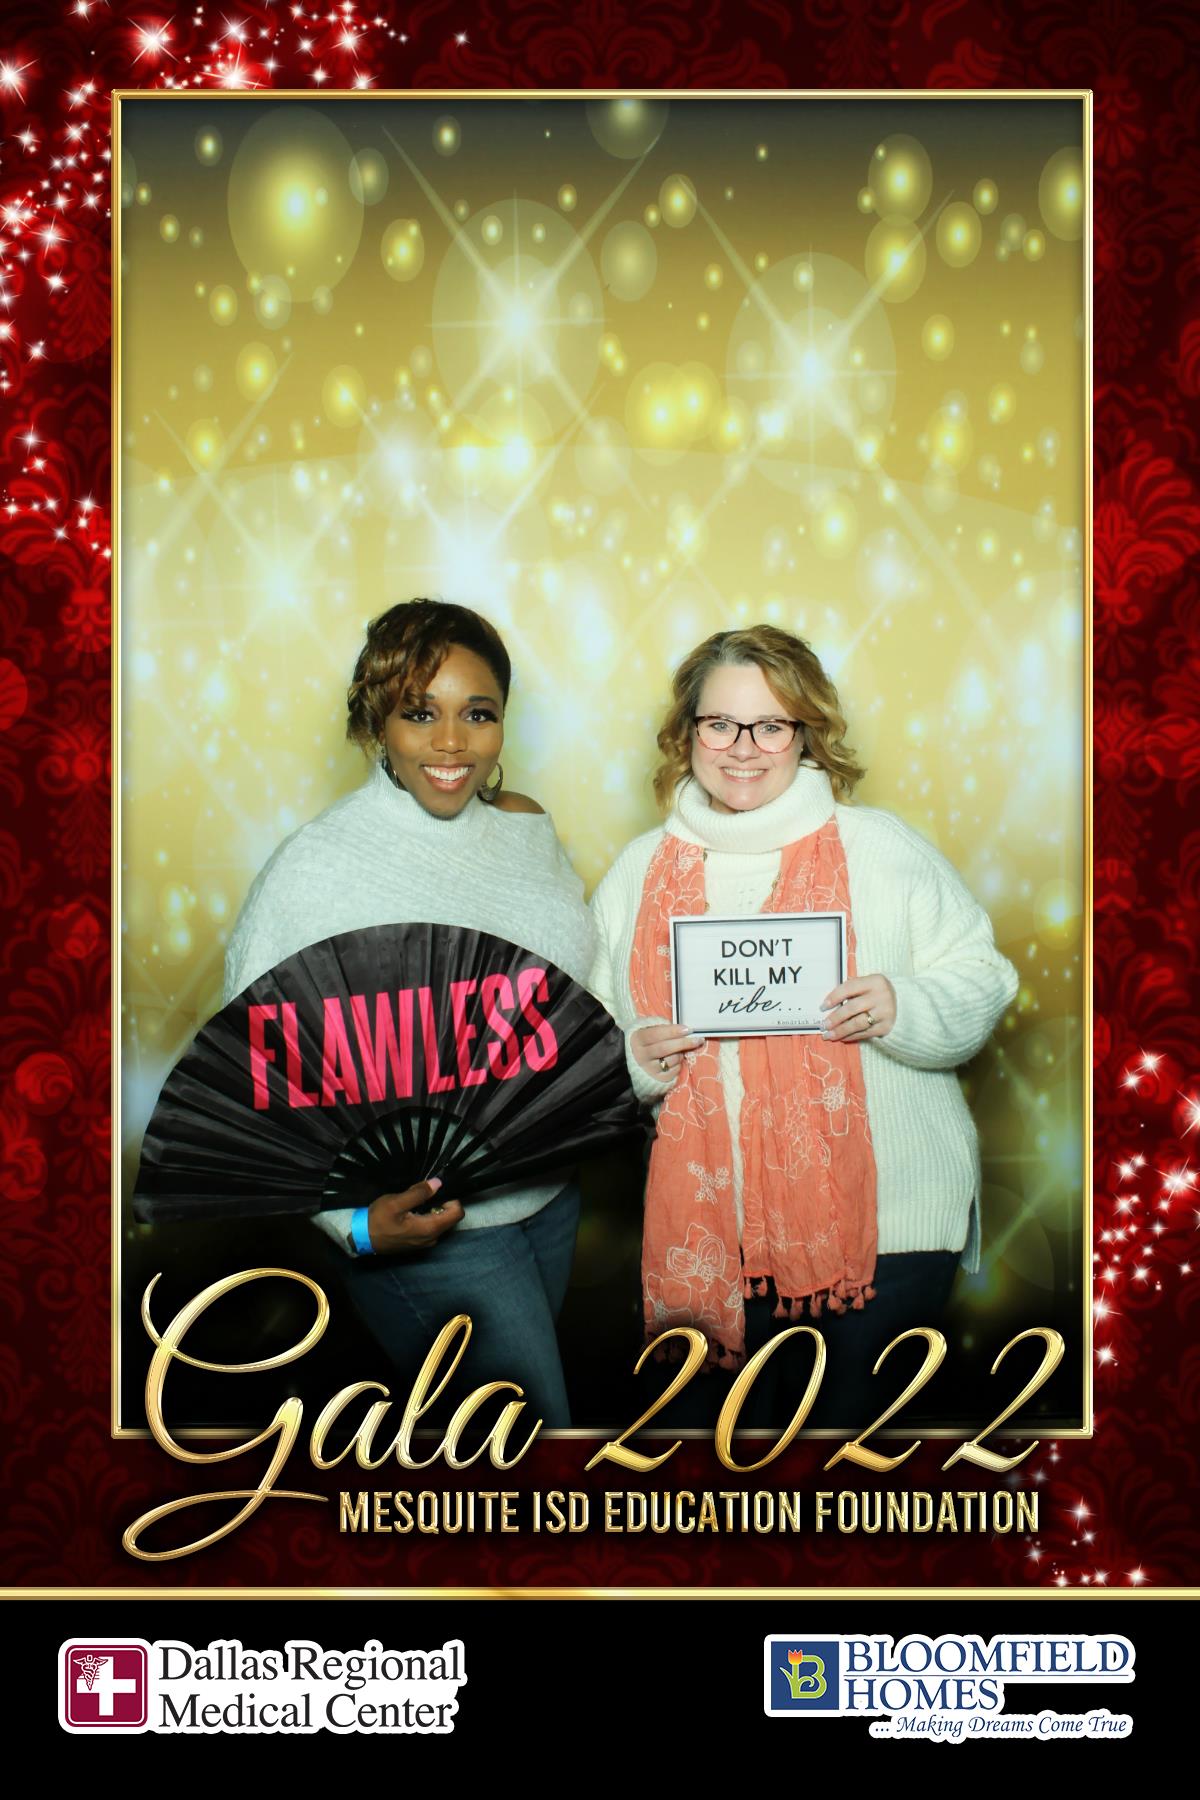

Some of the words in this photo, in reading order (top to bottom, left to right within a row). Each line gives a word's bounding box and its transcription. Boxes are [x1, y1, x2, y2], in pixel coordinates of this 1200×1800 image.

[721, 938, 793, 958] DON'T
[714, 968, 755, 986] KILL
[768, 966, 803, 984] MY
[247, 967, 560, 1110] FLAWLESS
